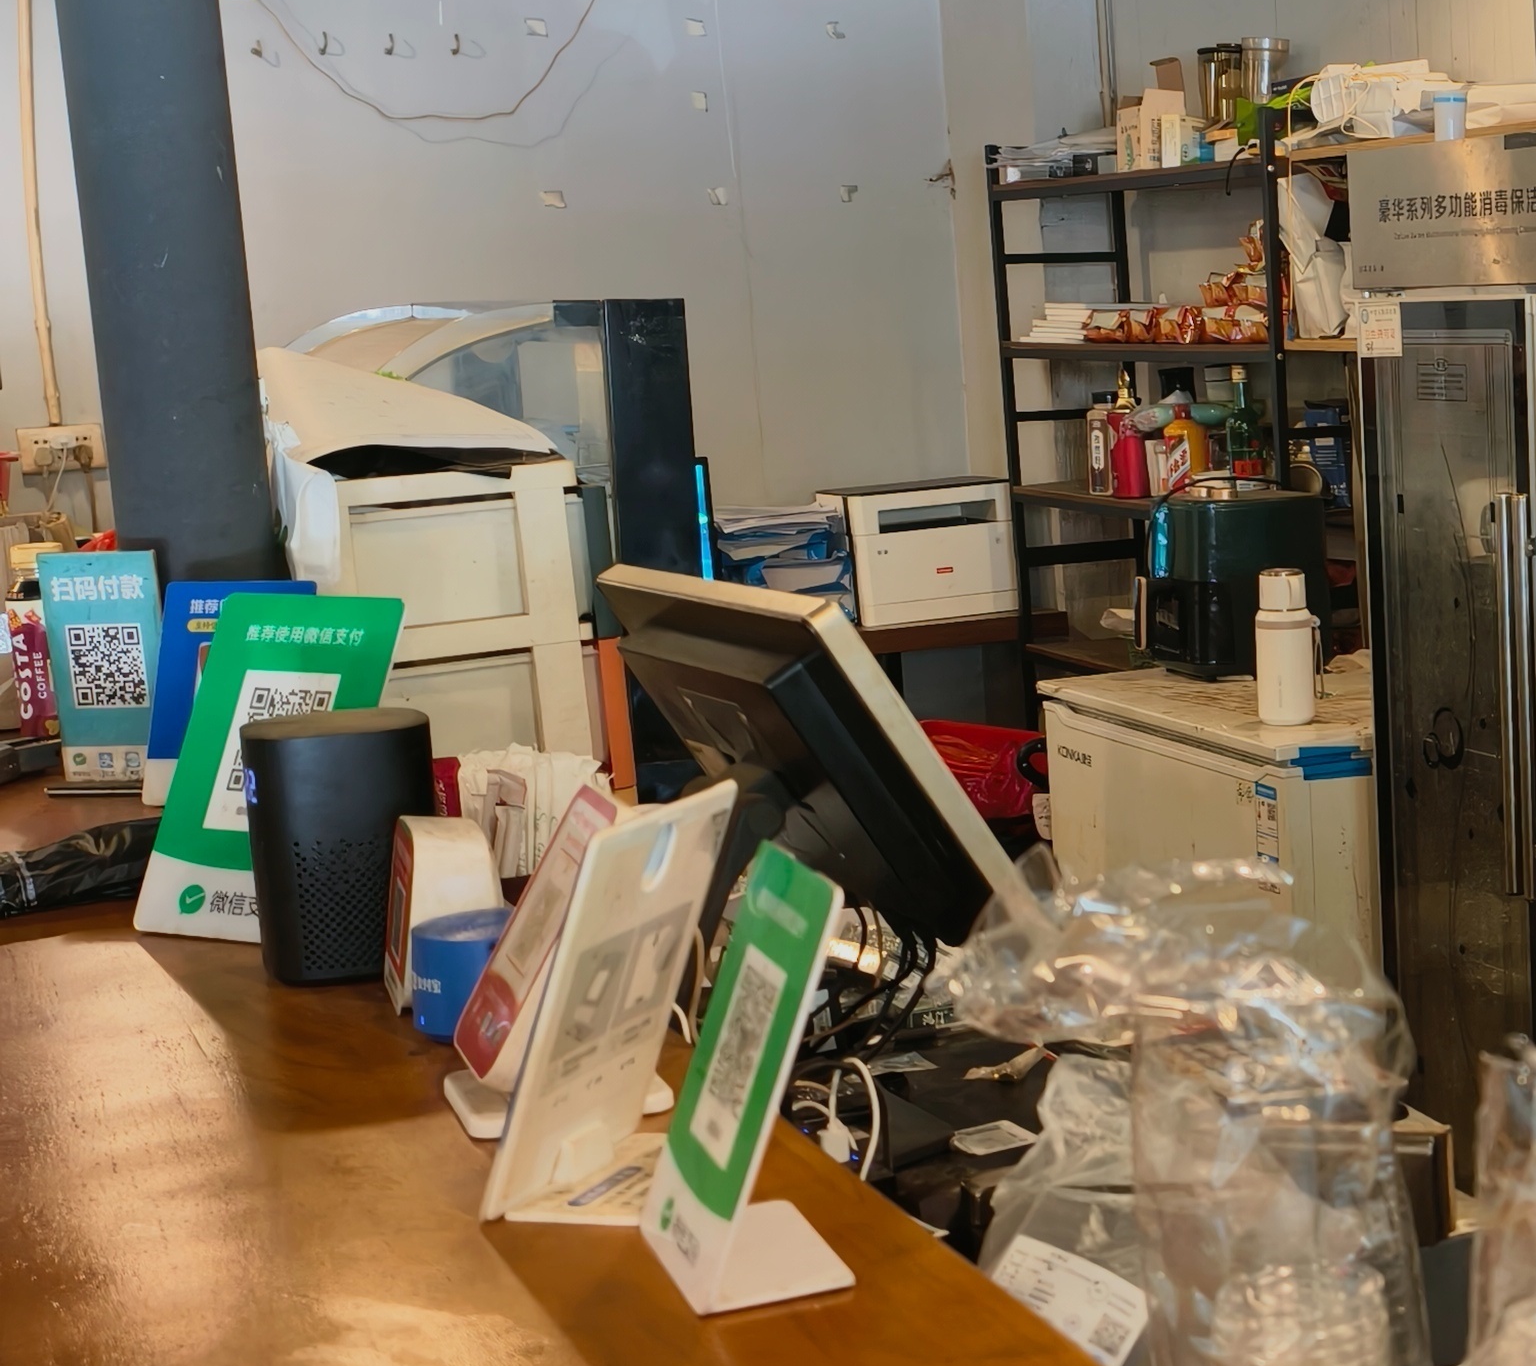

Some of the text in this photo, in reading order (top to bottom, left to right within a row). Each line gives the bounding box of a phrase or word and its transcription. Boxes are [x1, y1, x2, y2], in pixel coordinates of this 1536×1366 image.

[50, 574, 144, 602] 扫码付款
[189, 598, 223, 615] 推荐
[245, 624, 365, 647] 推荐使用微信支付
[12, 633, 34, 721] COSTA
[32, 651, 48, 699] COFFEE
